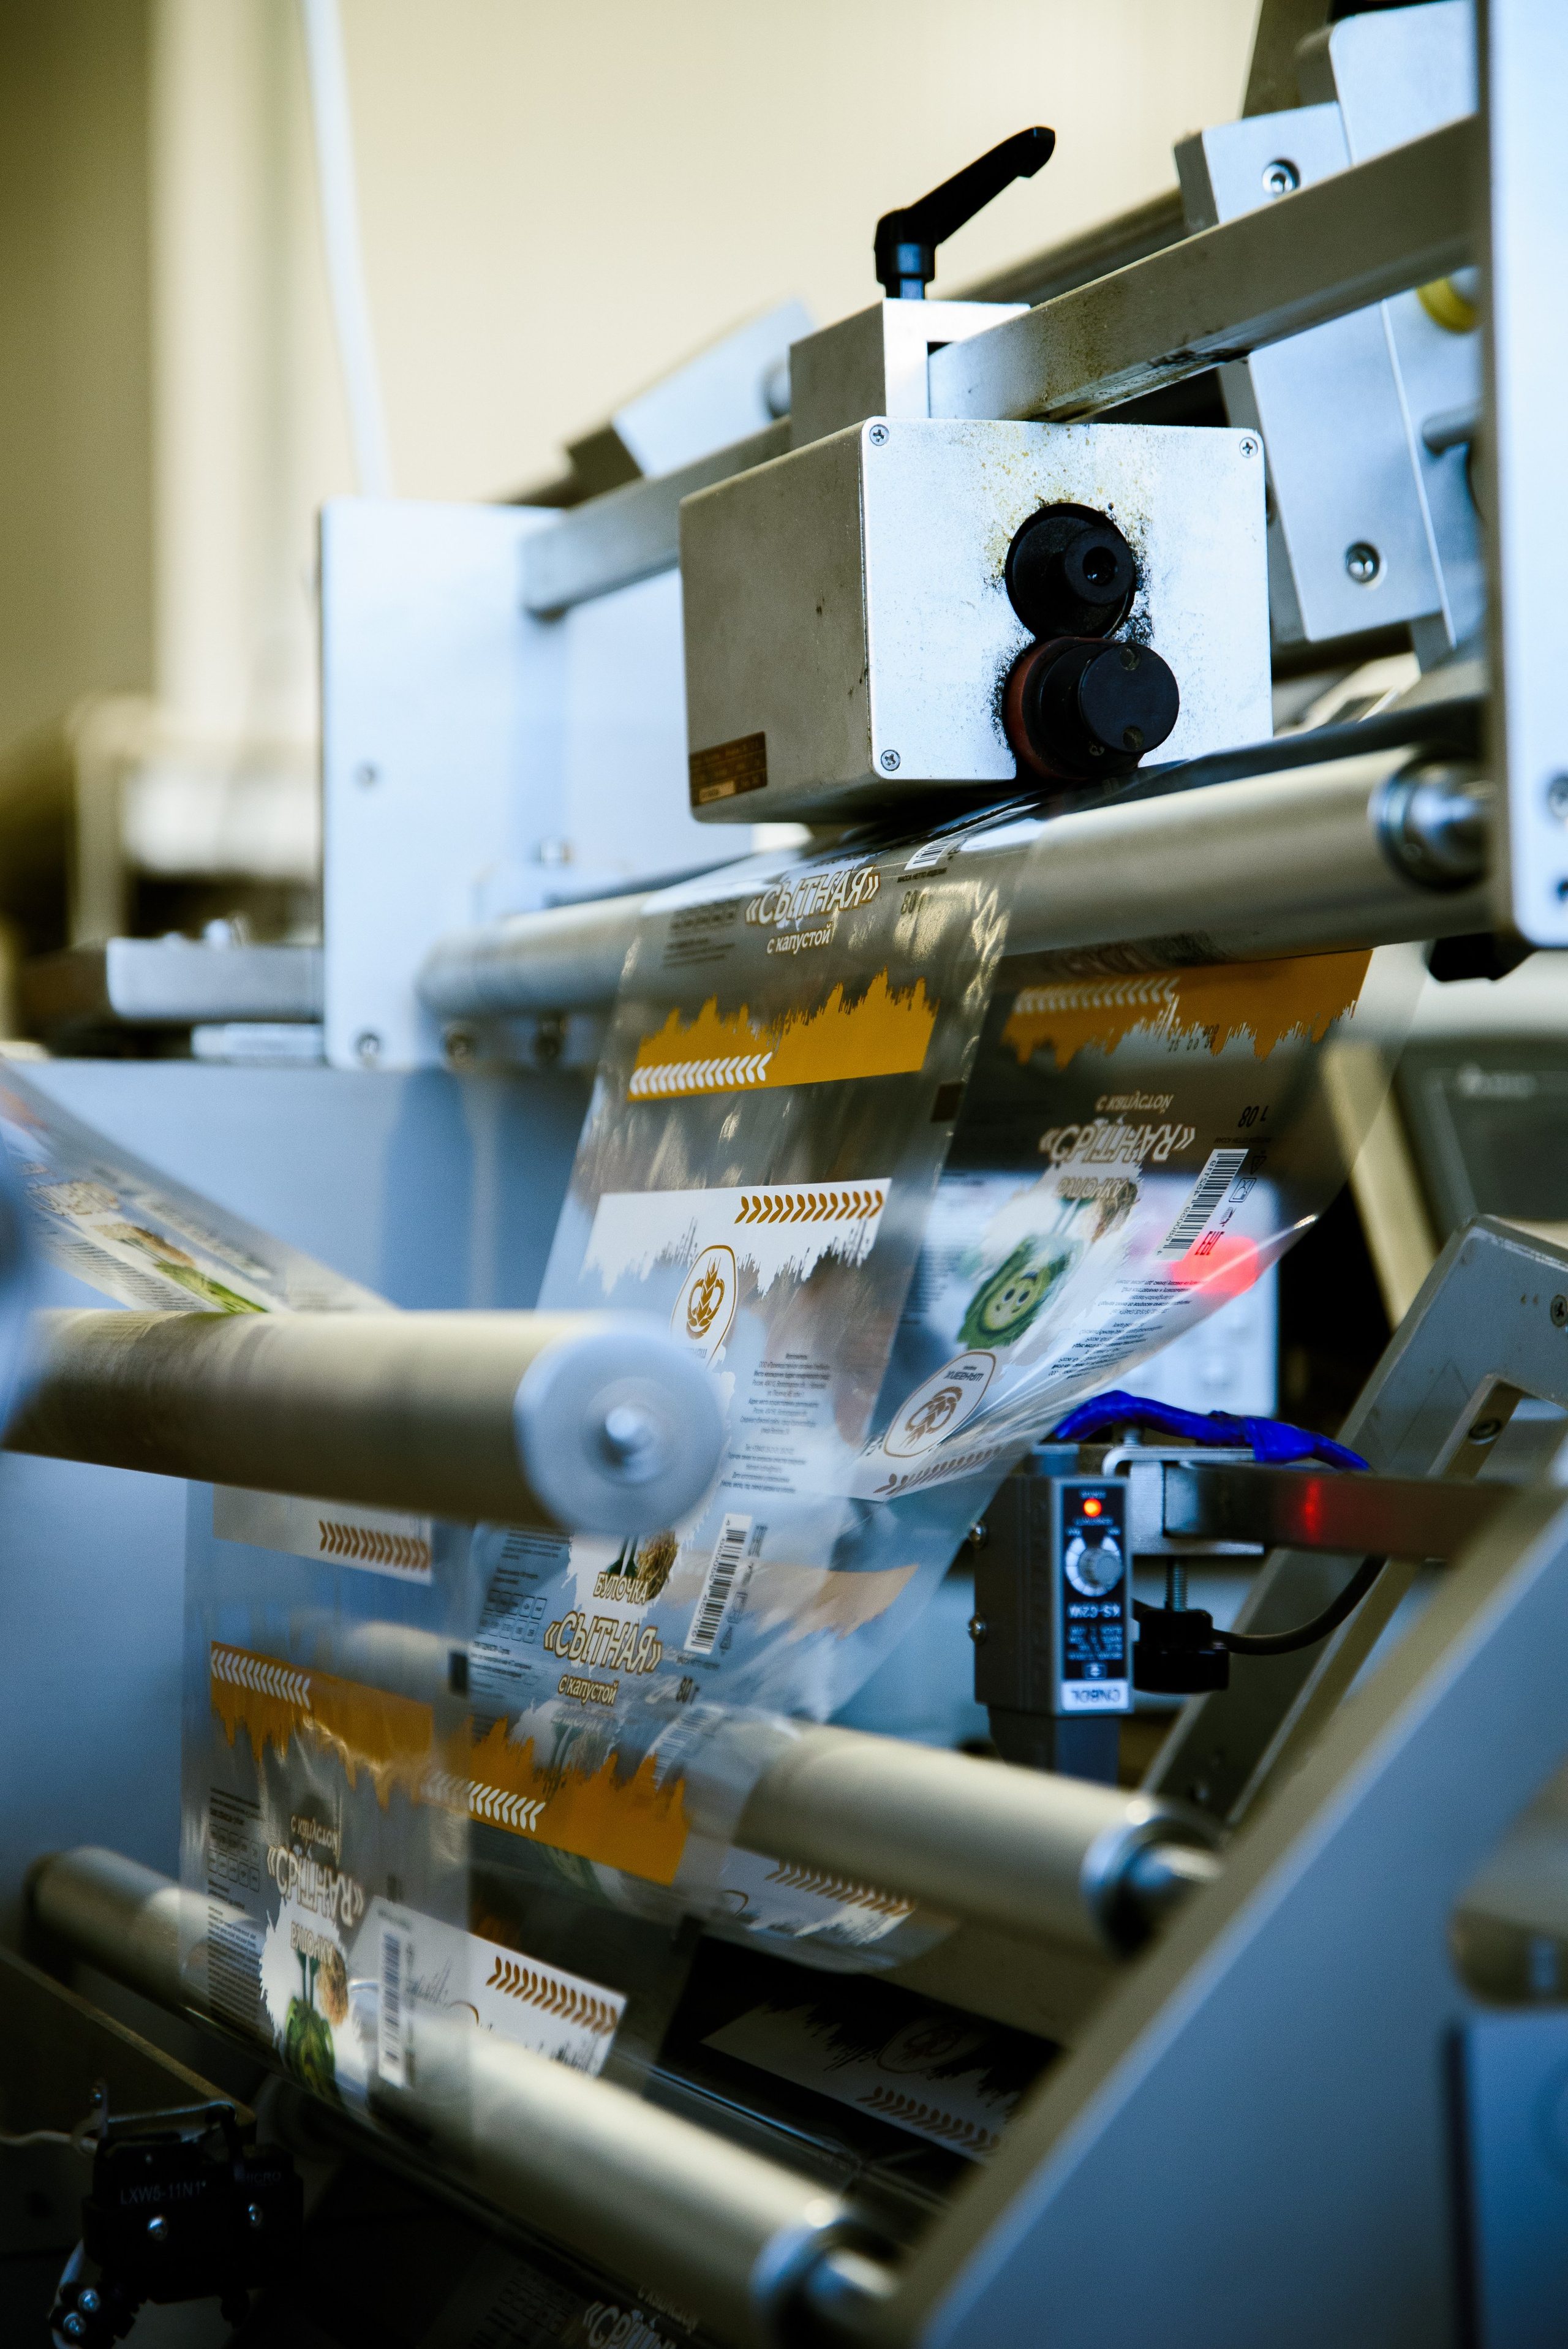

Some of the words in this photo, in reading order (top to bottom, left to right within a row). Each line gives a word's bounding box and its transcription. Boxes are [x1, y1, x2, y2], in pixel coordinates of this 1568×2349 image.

[745, 864, 881, 923] «СЫТНАЯ»
[775, 923, 834, 955] капустой
[593, 1572, 650, 1605] БУЛОЧКА
[544, 1612, 662, 1675] «СЫТНАЯ»
[558, 1675, 567, 1694] с
[566, 1678, 619, 1706] капустой
